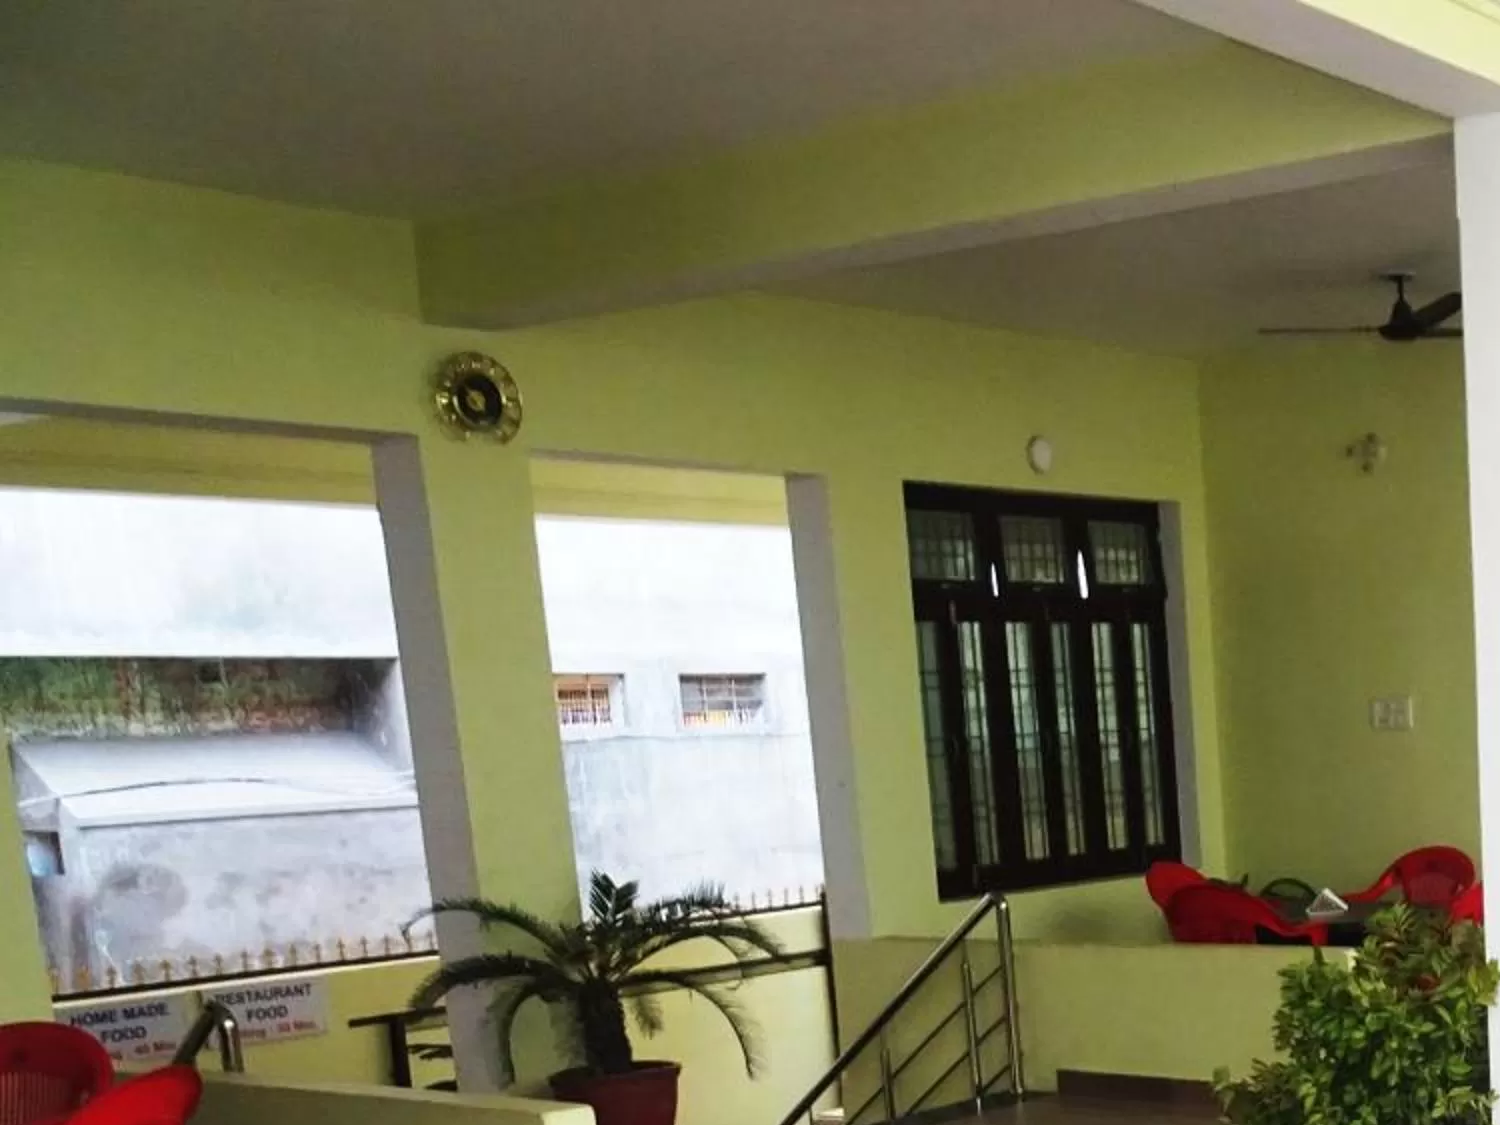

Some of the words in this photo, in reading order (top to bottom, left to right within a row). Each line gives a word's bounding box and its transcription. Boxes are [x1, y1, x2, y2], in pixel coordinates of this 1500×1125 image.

[215, 982, 311, 1005] RESTAURANT
[70, 1007, 117, 1027] HOME
[122, 1001, 169, 1021] MADE
[246, 1004, 288, 1022] FOOD
[101, 1025, 147, 1044] FOOD
